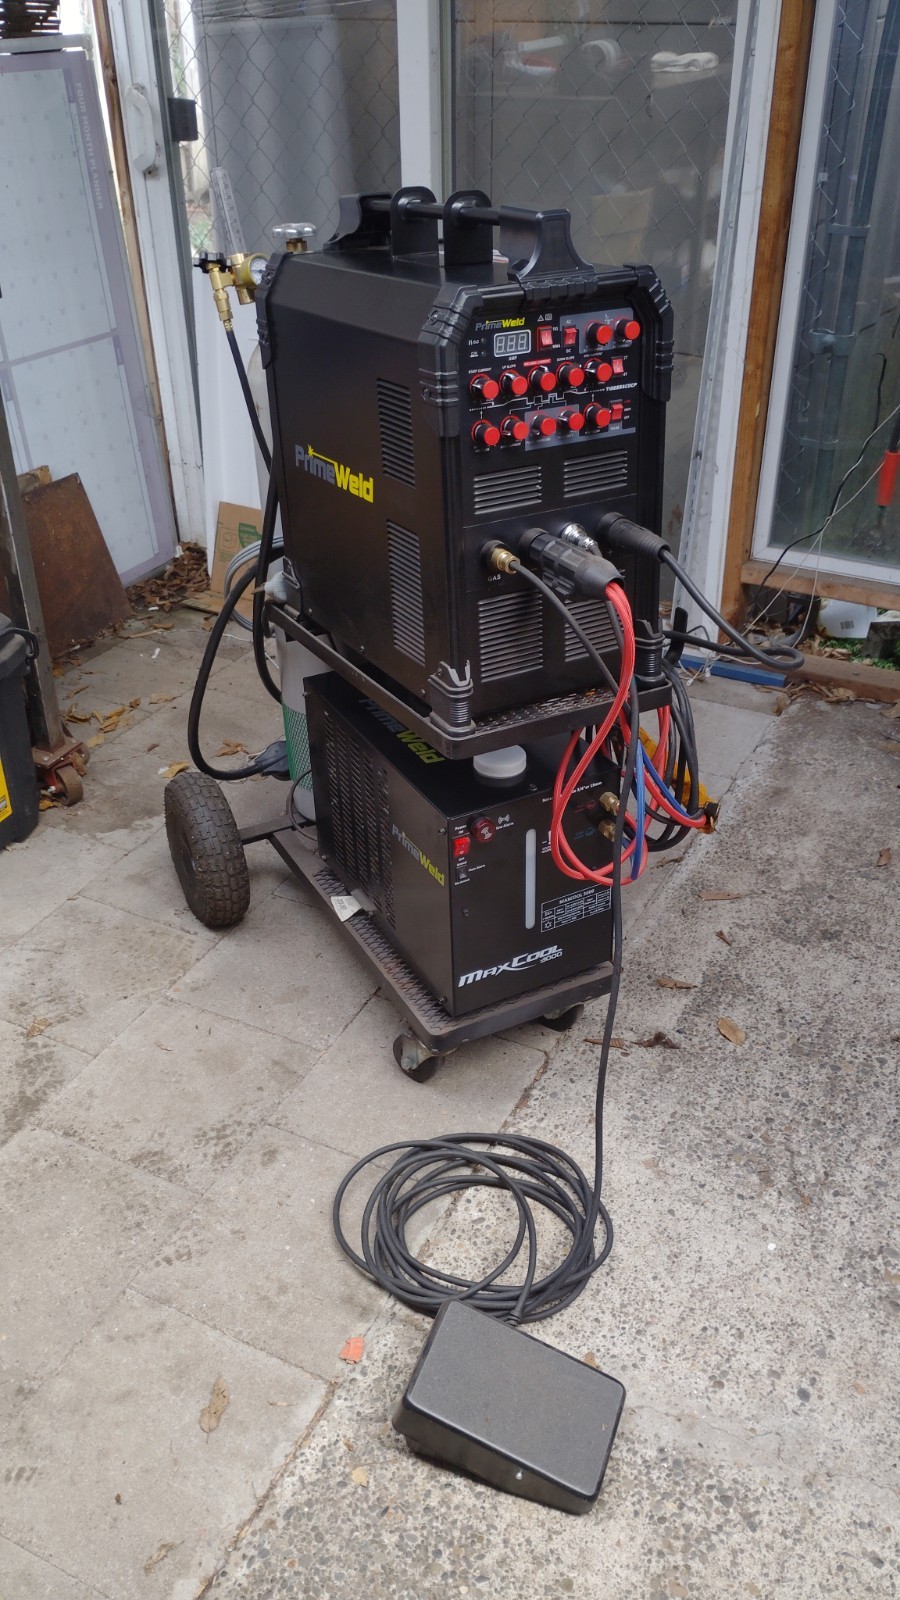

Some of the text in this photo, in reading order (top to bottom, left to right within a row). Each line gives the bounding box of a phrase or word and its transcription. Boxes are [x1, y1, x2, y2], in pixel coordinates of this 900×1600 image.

[75, 83, 104, 209] FOUR MONTH PLANNER
[475, 317, 526, 331] PrimeWeld
[294, 443, 374, 503] PrimeWeld
[487, 573, 502, 582] GAS
[392, 823, 445, 887] PrimeWeld
